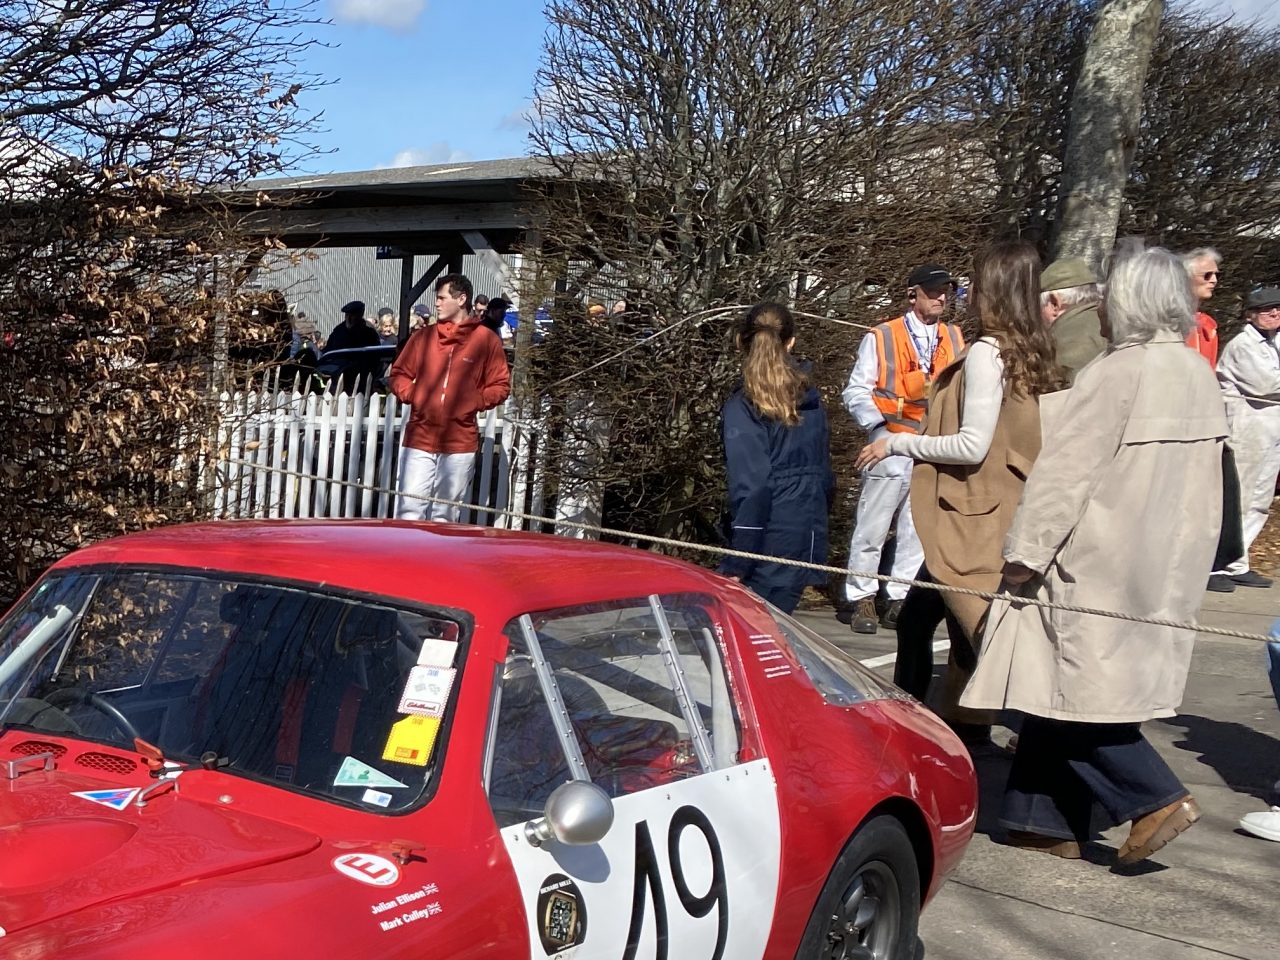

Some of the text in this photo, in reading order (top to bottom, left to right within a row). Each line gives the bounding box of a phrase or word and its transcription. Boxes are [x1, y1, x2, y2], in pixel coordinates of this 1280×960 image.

[371, 889, 426, 915] Julian Ellison
[380, 908, 430, 931] Mark Culley
